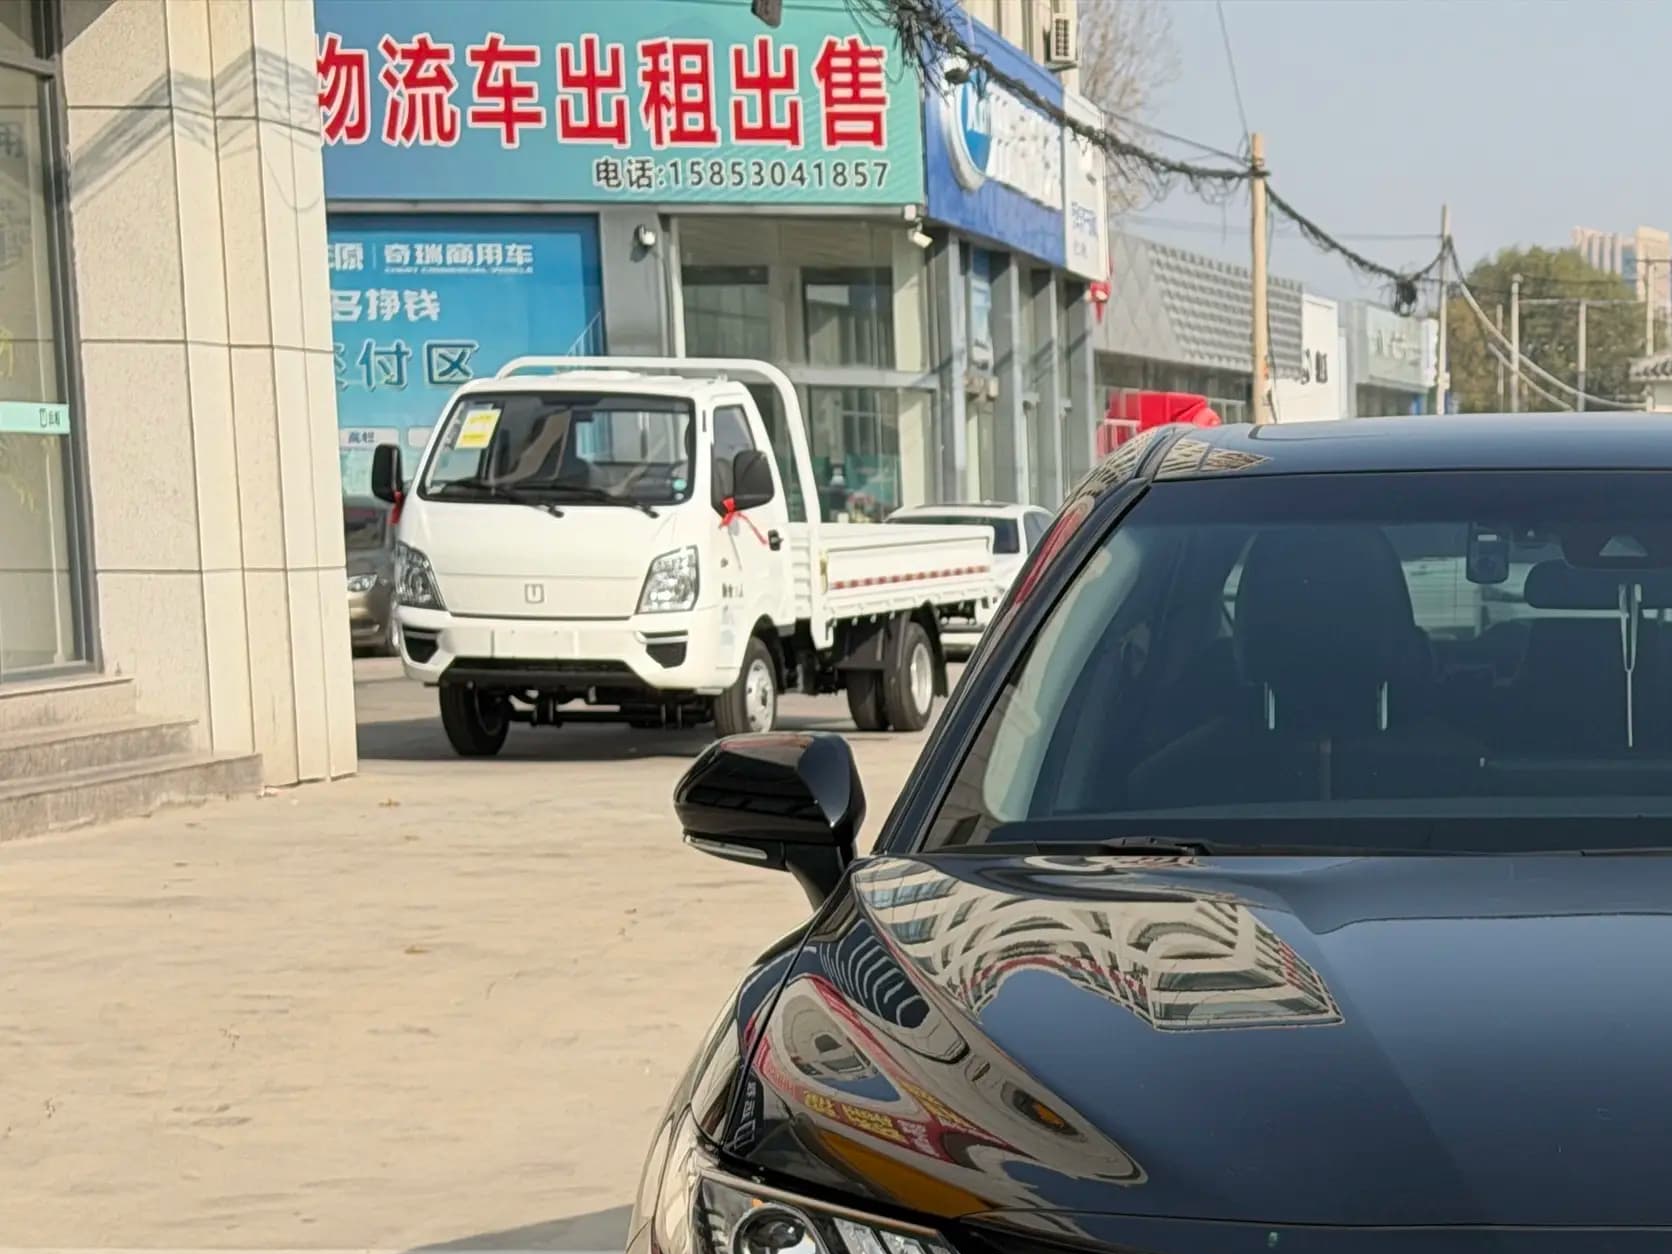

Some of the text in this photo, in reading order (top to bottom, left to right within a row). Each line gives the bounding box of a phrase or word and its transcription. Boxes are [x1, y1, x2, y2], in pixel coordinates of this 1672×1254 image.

[316, 34, 889, 149] 物流车出租出售
[594, 157, 890, 191] 电话:15853041857
[383, 242, 534, 266] 奇瑞商用车
